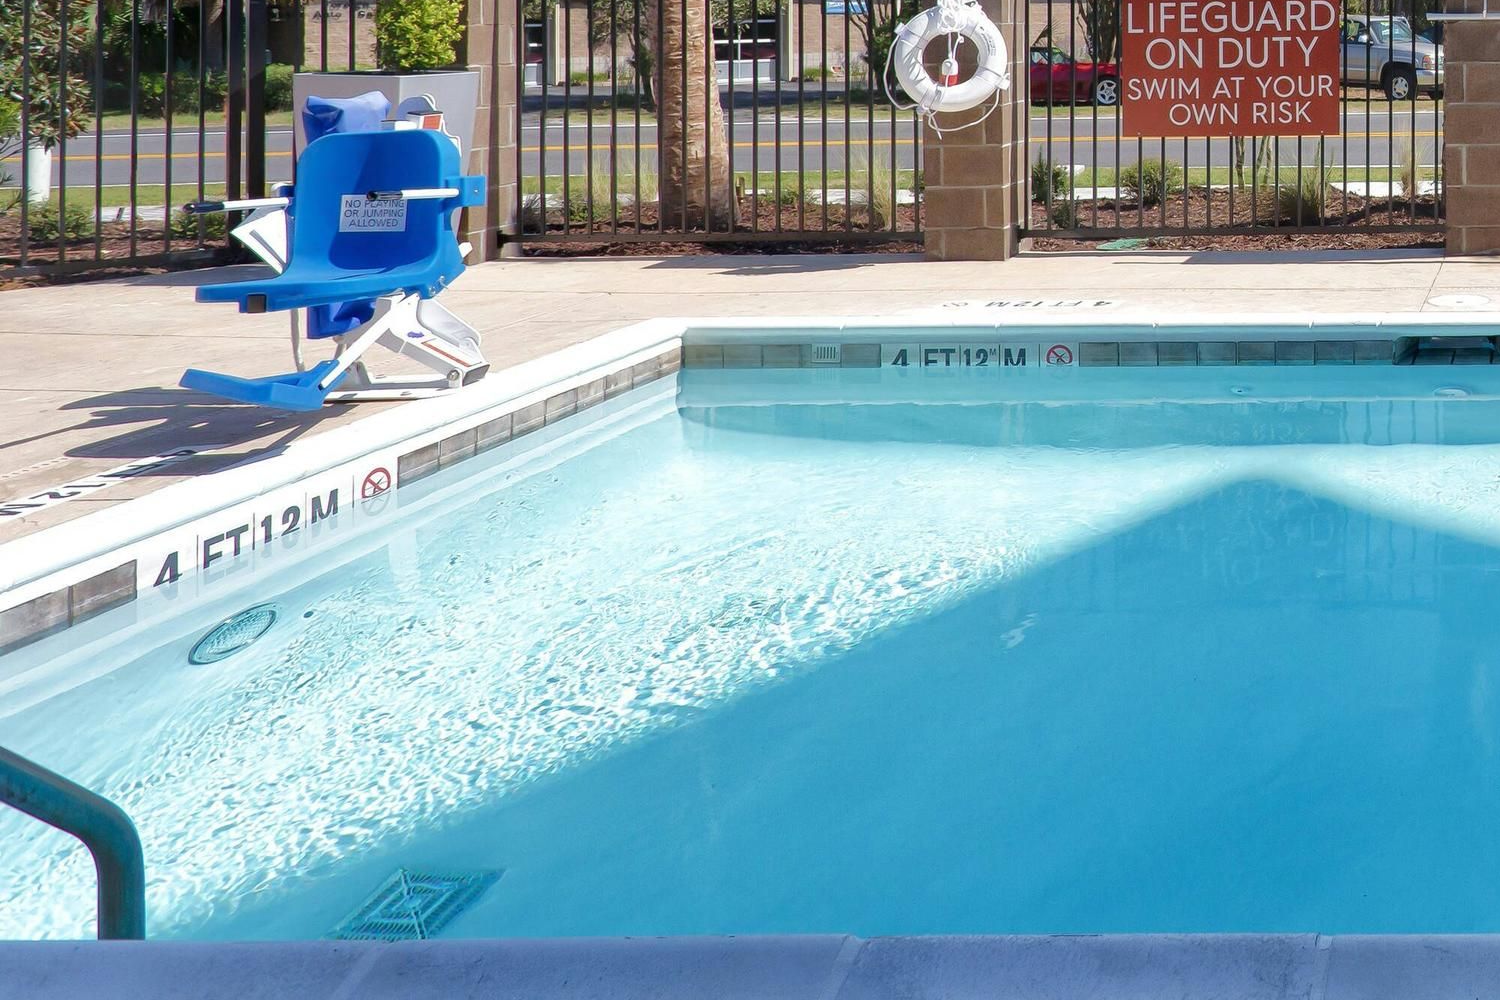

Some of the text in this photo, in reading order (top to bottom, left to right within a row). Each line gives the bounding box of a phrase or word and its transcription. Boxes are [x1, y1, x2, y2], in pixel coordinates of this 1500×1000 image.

[1127, 0, 1336, 34] LIFEGUARD
[1145, 36, 1319, 70] ON DUTY
[1127, 75, 1333, 101] SWIM AT YOUR
[1169, 101, 1312, 126] OWN RISK
[344, 209, 404, 218] OR JUMPING
[345, 199, 404, 208] NO PLAYING
[349, 219, 399, 227] ALLOWED
[891, 348, 910, 367] 4
[924, 348, 956, 367] FT
[153, 550, 183, 588] 4
[203, 523, 249, 570] FT
[311, 488, 339, 525] M
